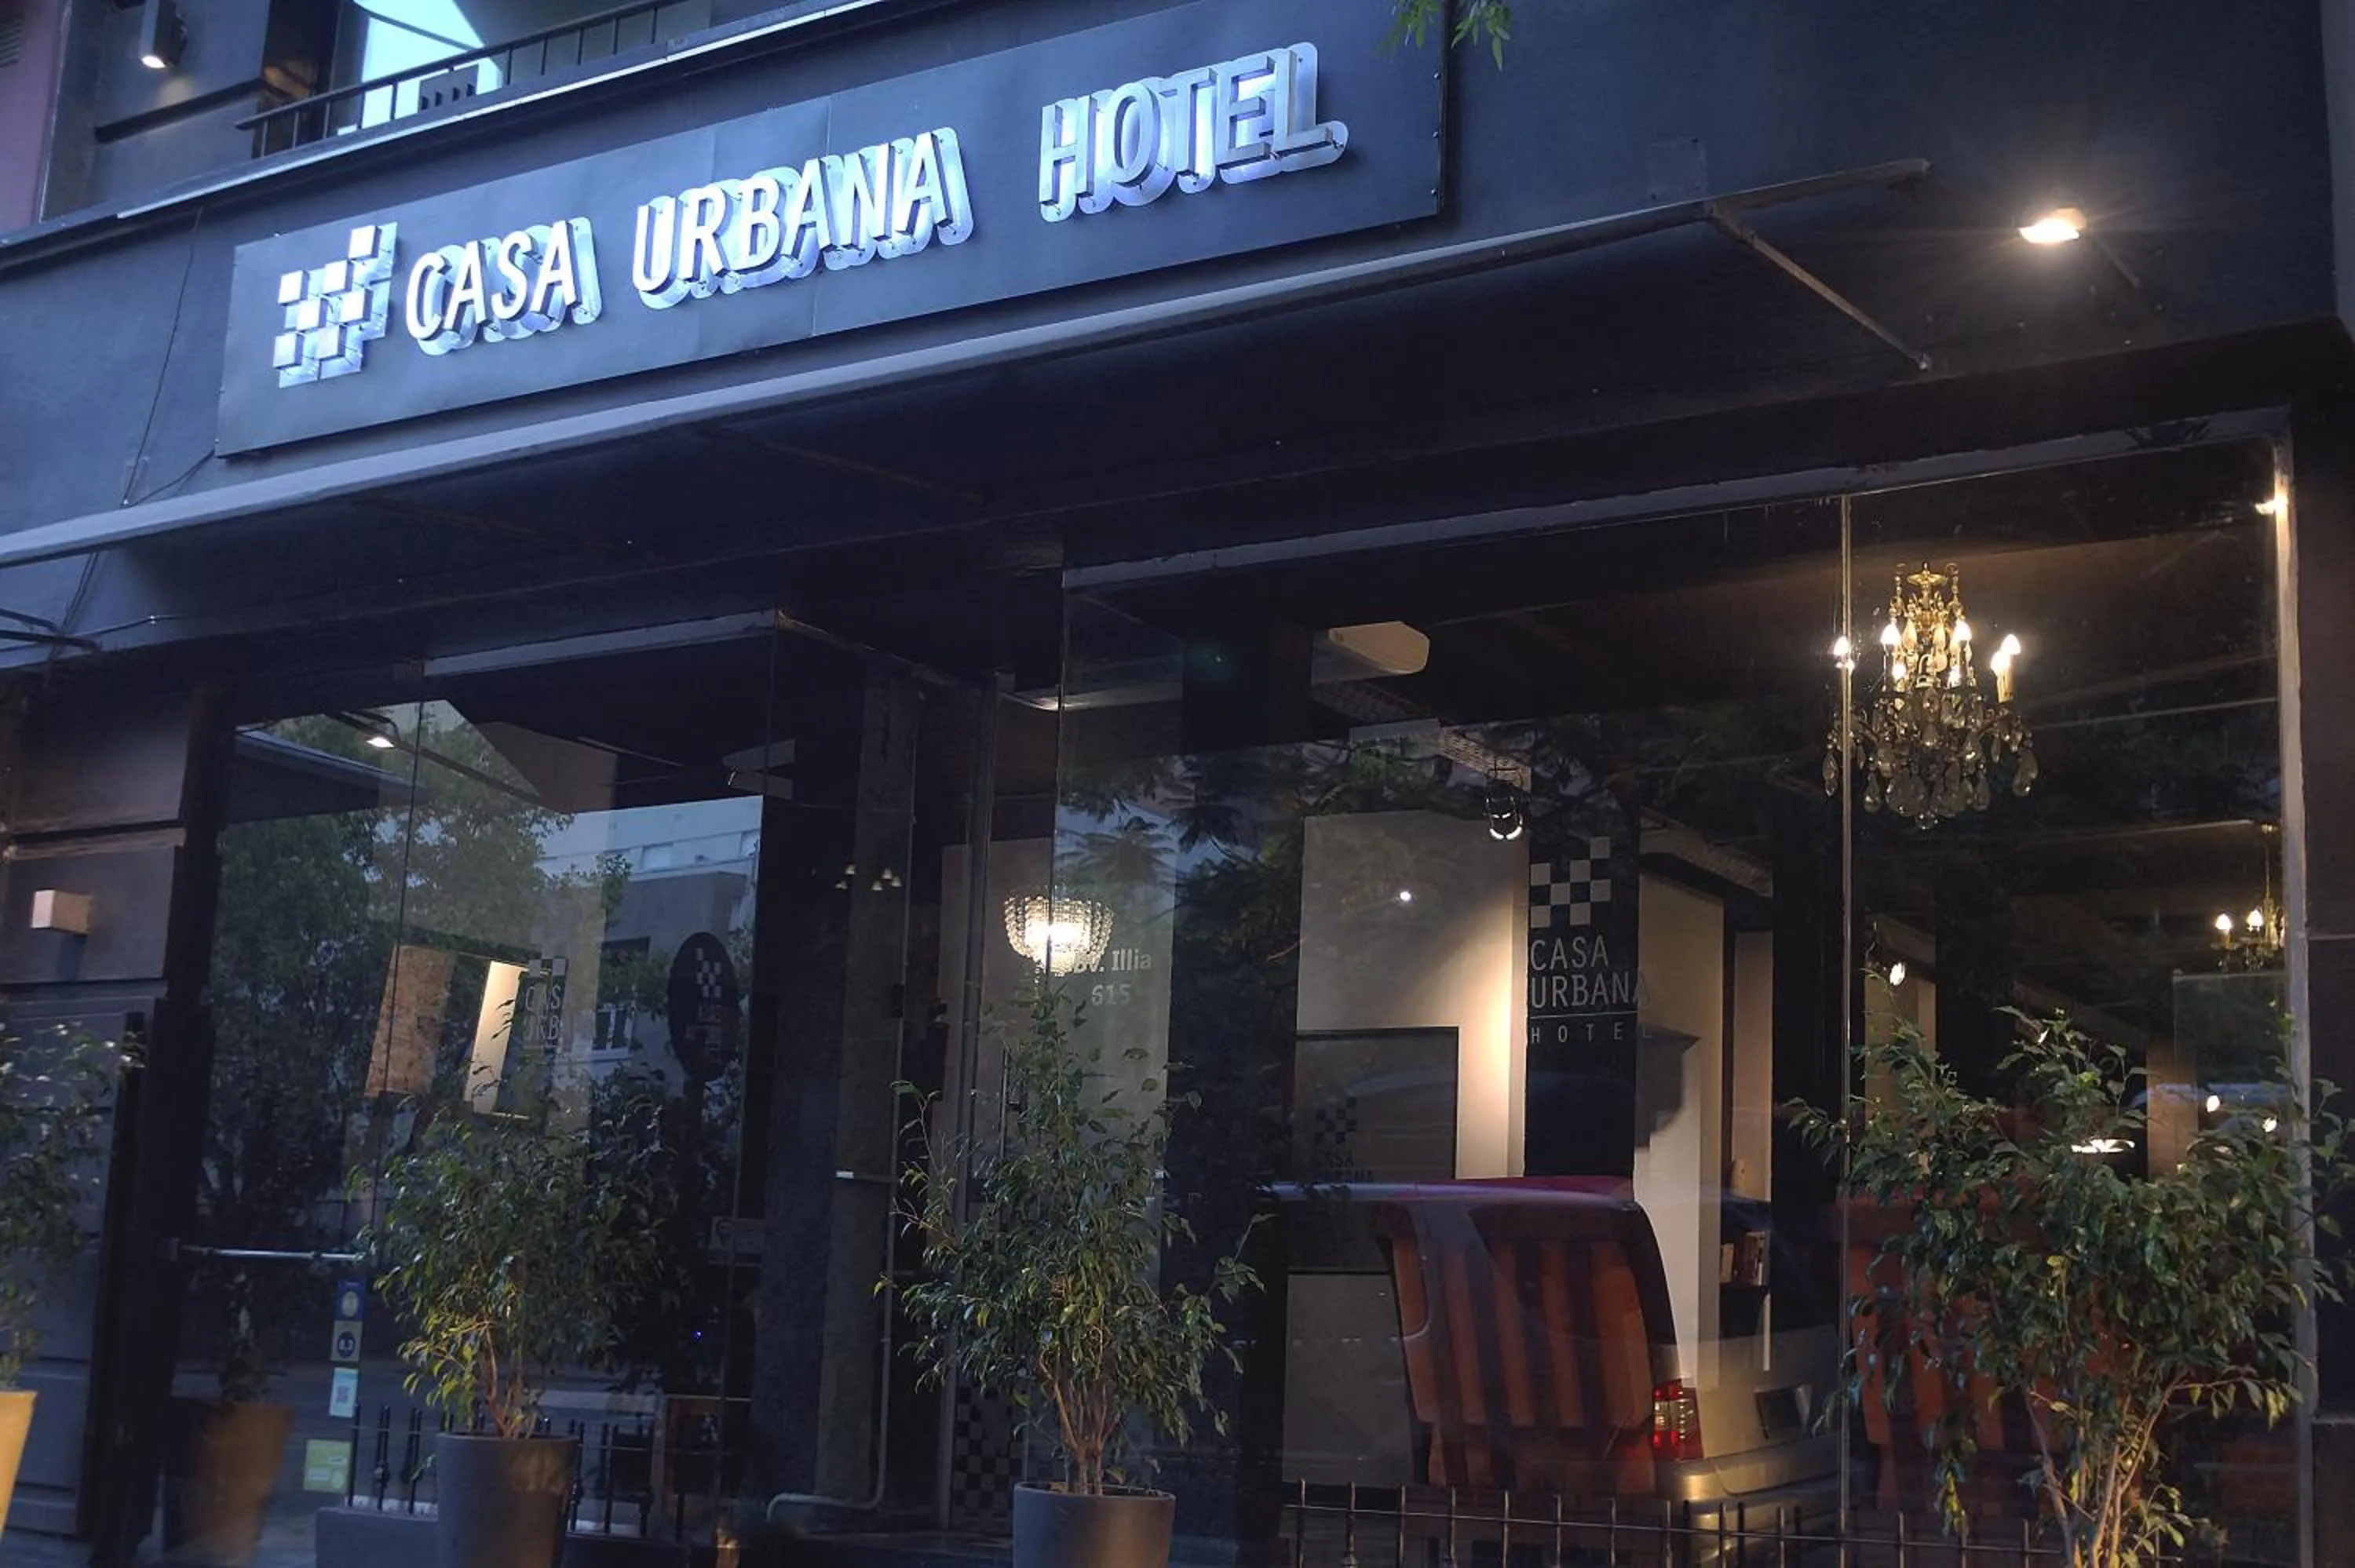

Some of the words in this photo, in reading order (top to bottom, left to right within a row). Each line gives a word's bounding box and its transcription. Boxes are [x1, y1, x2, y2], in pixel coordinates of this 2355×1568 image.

[406, 219, 585, 344] CASA
[631, 130, 959, 297] URBANA
[1038, 44, 1339, 209] HOTEL
[1111, 948, 1152, 971] Illia
[1531, 935, 1609, 971] CASA
[1091, 983, 1132, 1006] 615
[1531, 1021, 1653, 1044] HOTEL
